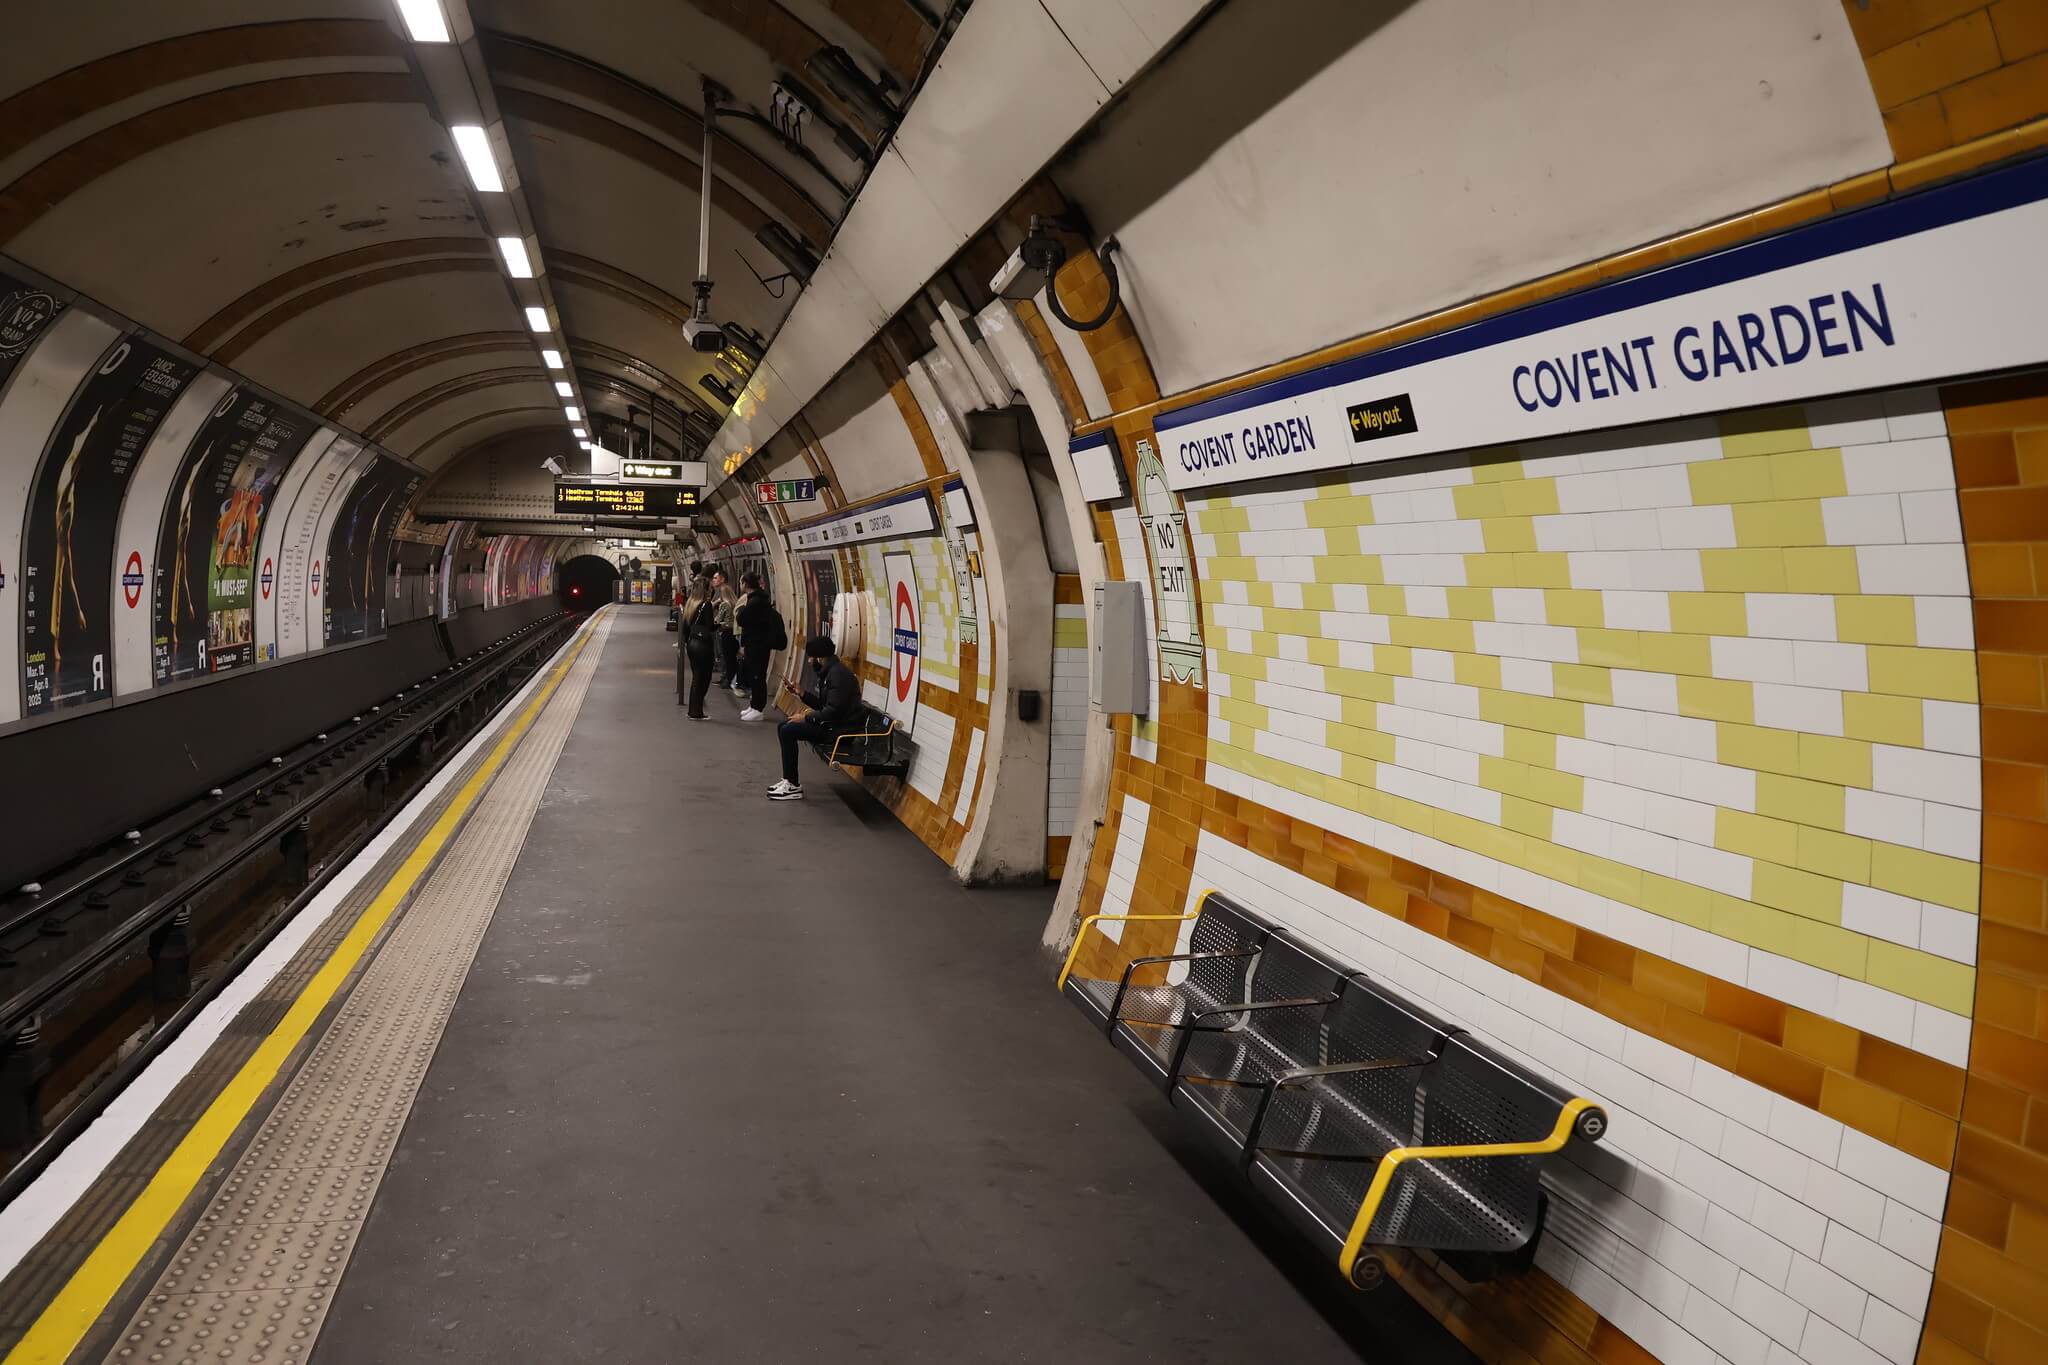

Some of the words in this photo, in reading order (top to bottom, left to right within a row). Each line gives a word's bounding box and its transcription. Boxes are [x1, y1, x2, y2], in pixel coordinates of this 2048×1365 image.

[1512, 335, 1658, 412] COVENT
[1673, 282, 1896, 383] GARDEN
[1359, 407, 1383, 432] Way
[1383, 404, 1403, 425] out
[1179, 432, 1238, 473] COVENT
[1242, 415, 1317, 461] GARDEN
[634, 464, 655, 477] Way
[655, 466, 673, 477] out
[557, 494, 564, 502] 3
[566, 494, 594, 503] Heathrow
[595, 495, 624, 503] Terminals
[559, 488, 563, 496] 1
[566, 488, 594, 496] Heathrow
[595, 488, 624, 497] Terminals
[683, 491, 694, 499] min
[1156, 521, 1175, 550] NO
[1159, 566, 1185, 593] EXIT
[894, 633, 906, 648] COVENT
[906, 635, 918, 651] GARDEN
[26, 650, 46, 664] London
[27, 693, 42, 707] 2025
